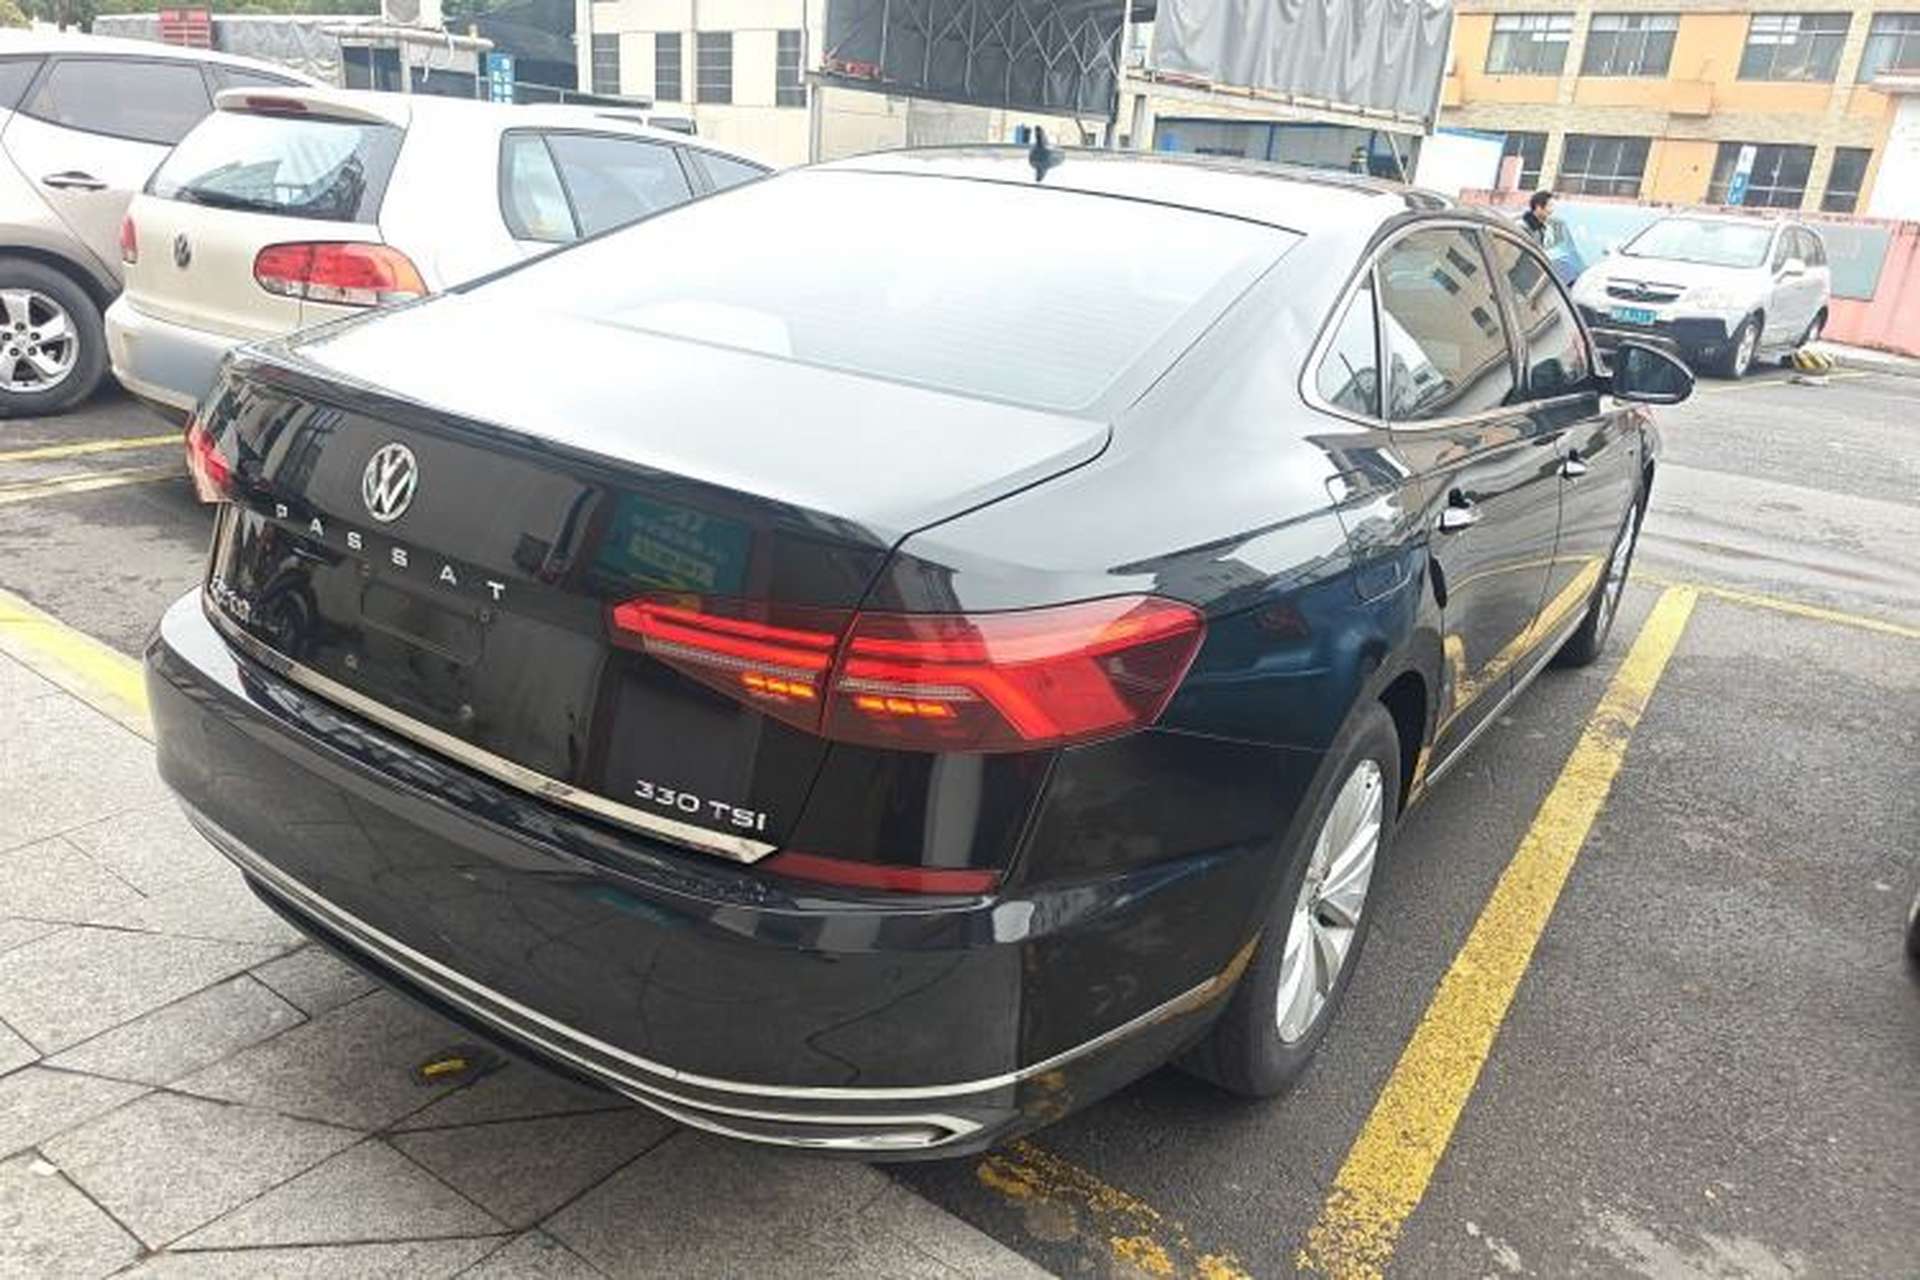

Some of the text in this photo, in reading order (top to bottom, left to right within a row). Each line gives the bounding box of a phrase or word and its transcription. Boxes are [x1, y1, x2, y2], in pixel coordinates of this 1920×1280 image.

[362, 442, 419, 522] VW
[275, 503, 506, 601] PASSAT
[634, 779, 767, 831] 330 TSI
